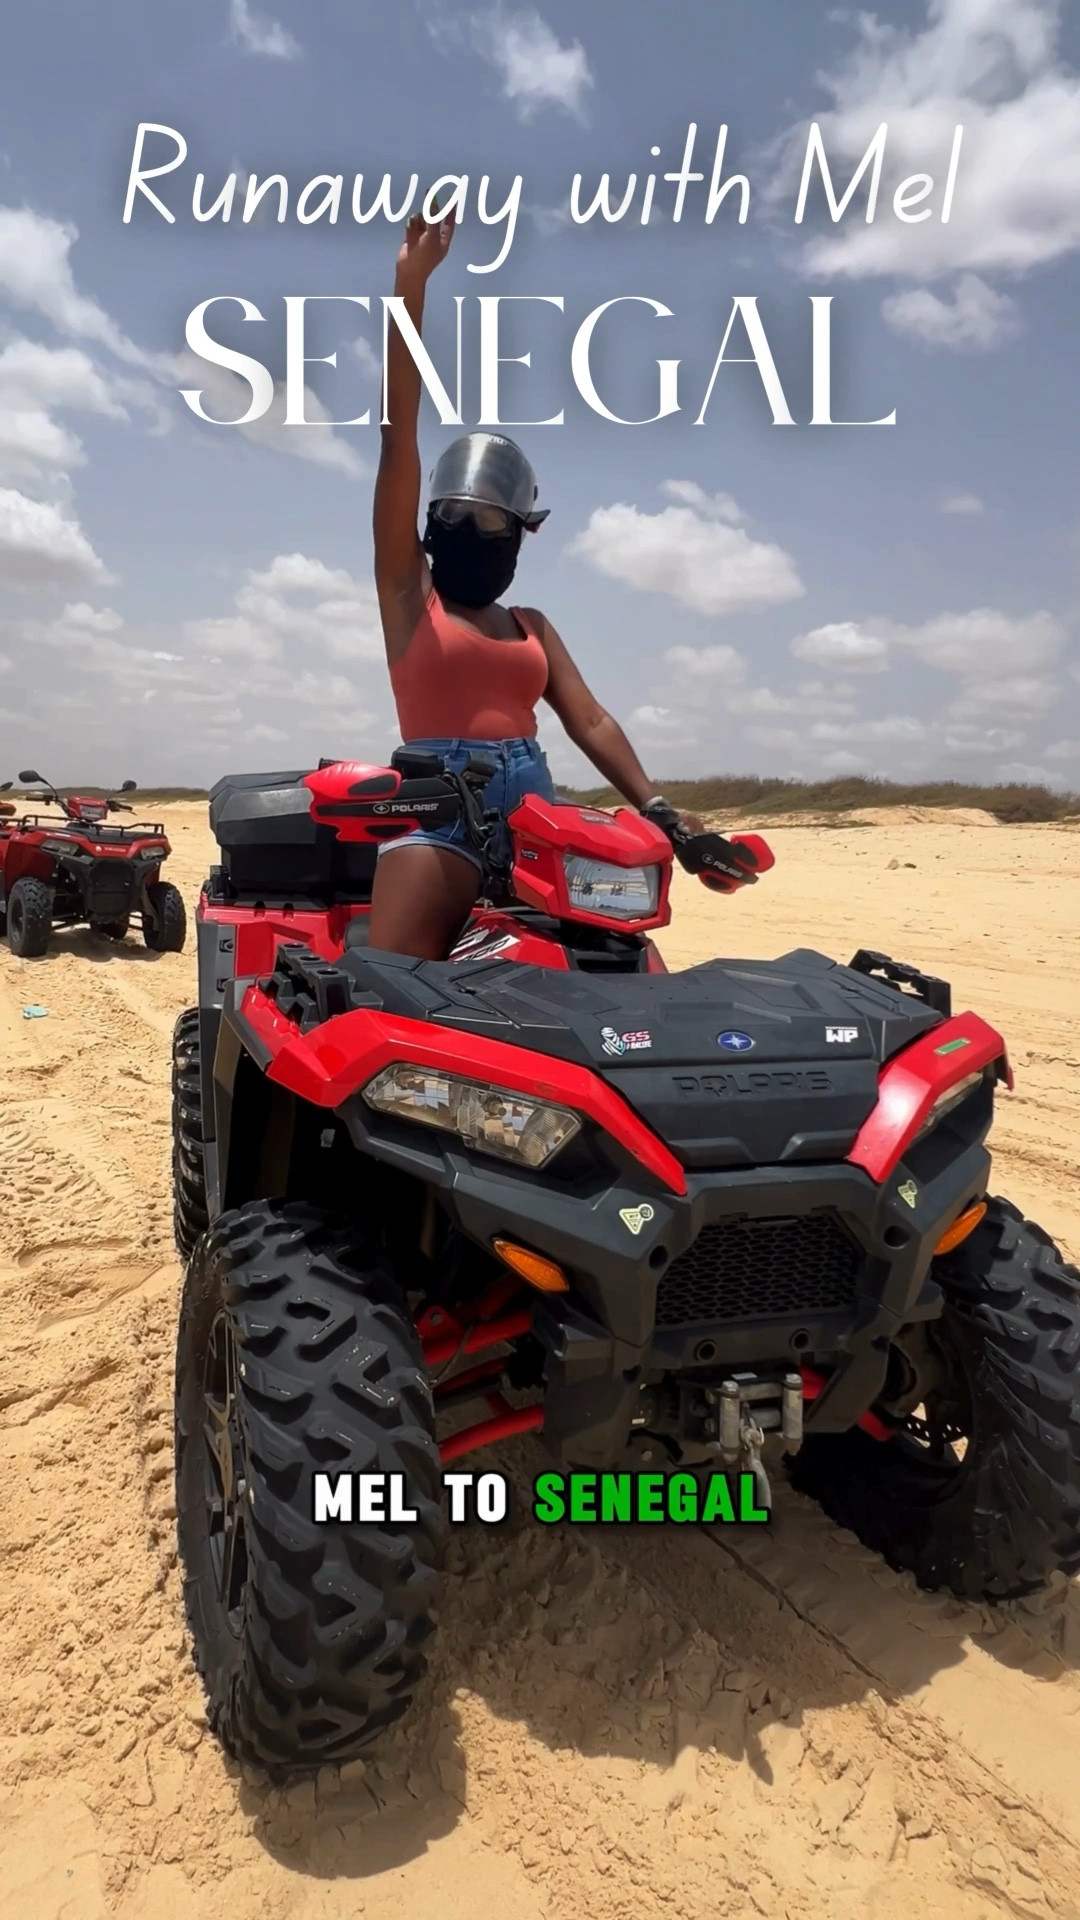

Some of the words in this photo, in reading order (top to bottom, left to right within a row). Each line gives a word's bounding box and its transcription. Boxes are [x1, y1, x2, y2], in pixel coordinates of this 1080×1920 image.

[391, 803, 439, 813] POLARIS
[621, 1030, 650, 1043] GS
[826, 1029, 859, 1043] WP
[672, 1070, 835, 1100] POLARIS
